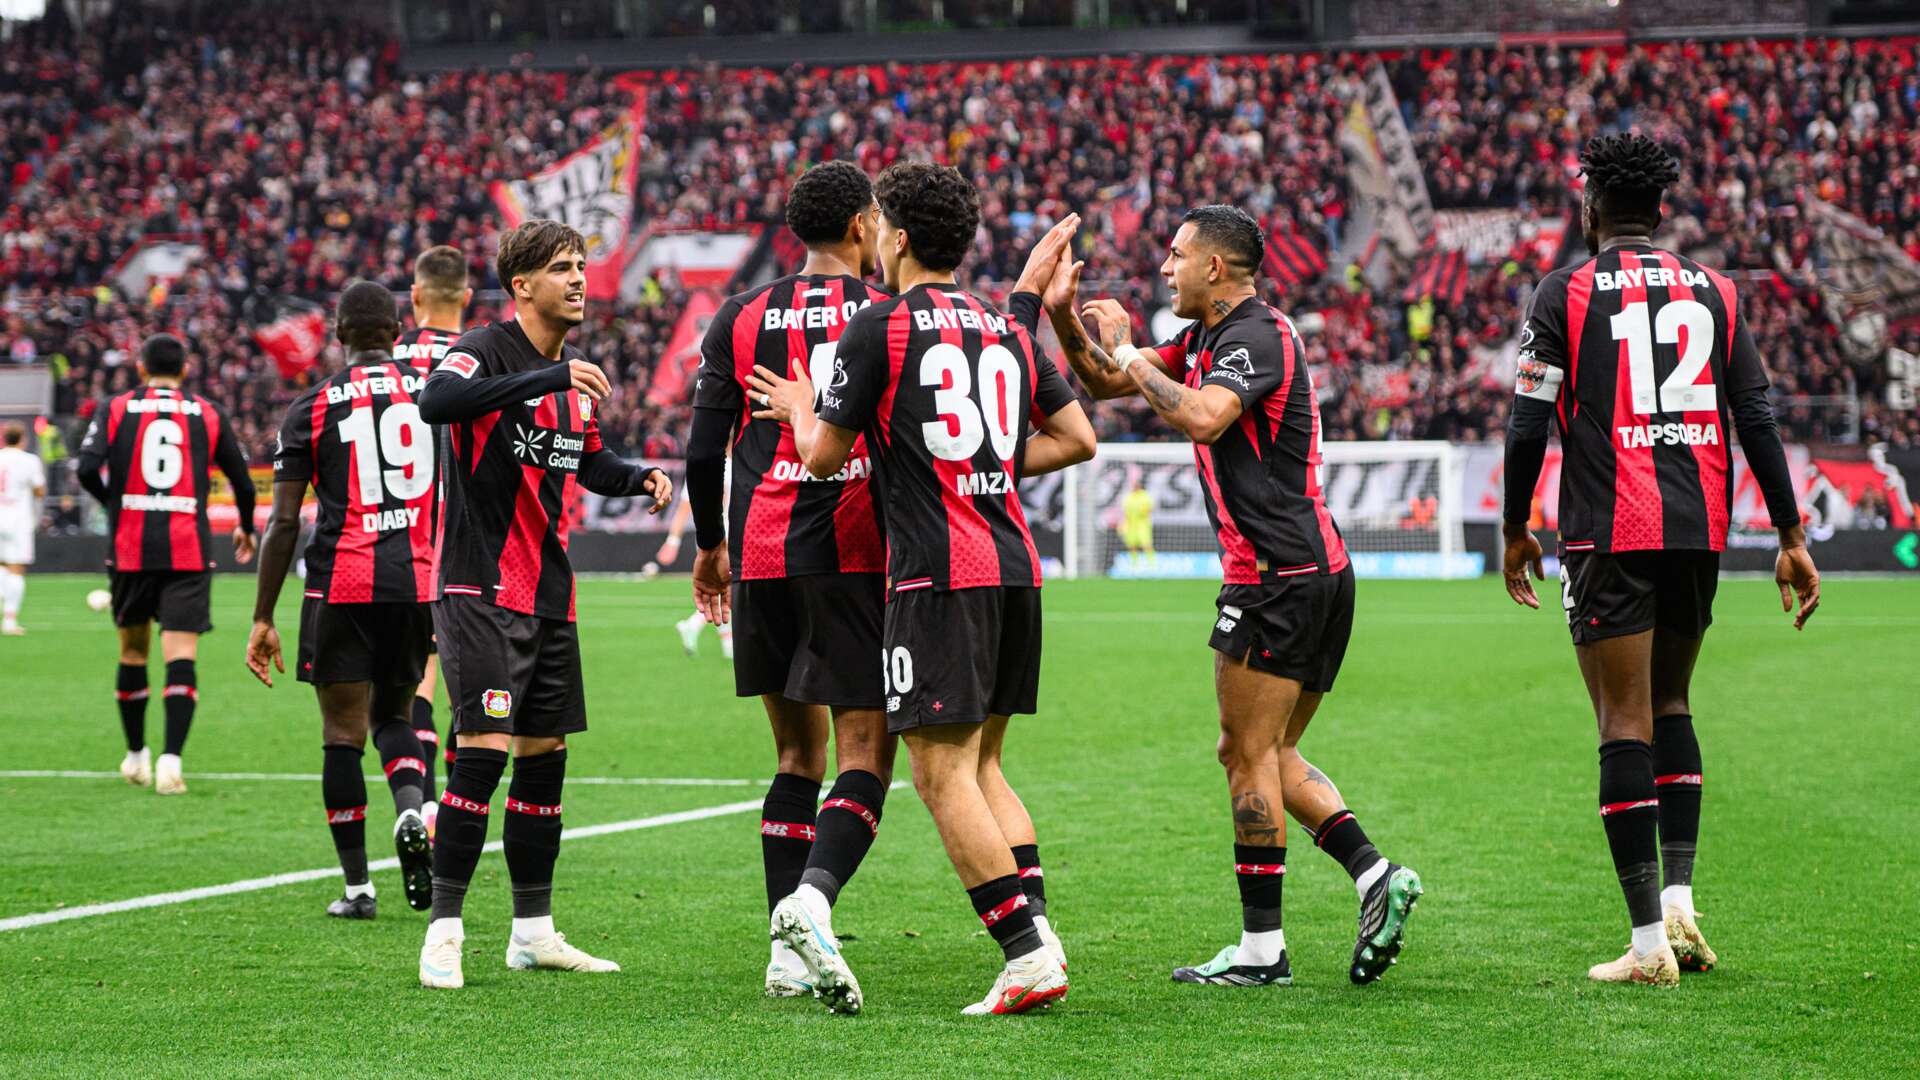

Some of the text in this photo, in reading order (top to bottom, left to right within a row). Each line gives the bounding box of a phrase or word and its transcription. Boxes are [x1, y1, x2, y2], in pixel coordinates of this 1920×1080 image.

[1594, 268, 1709, 291] BAYER 04
[765, 306, 838, 330] BAYER
[913, 308, 1008, 334] BAYER 04
[1610, 300, 1718, 414] 12
[326, 377, 398, 405] BAYER
[1209, 369, 1250, 391] NIEDAX
[127, 399, 180, 415] BAYER
[920, 343, 1021, 461] 30
[1618, 424, 1718, 448] TAPSOBA
[141, 418, 183, 489] 6
[337, 402, 434, 506] 19
[362, 507, 420, 533] DIABY
